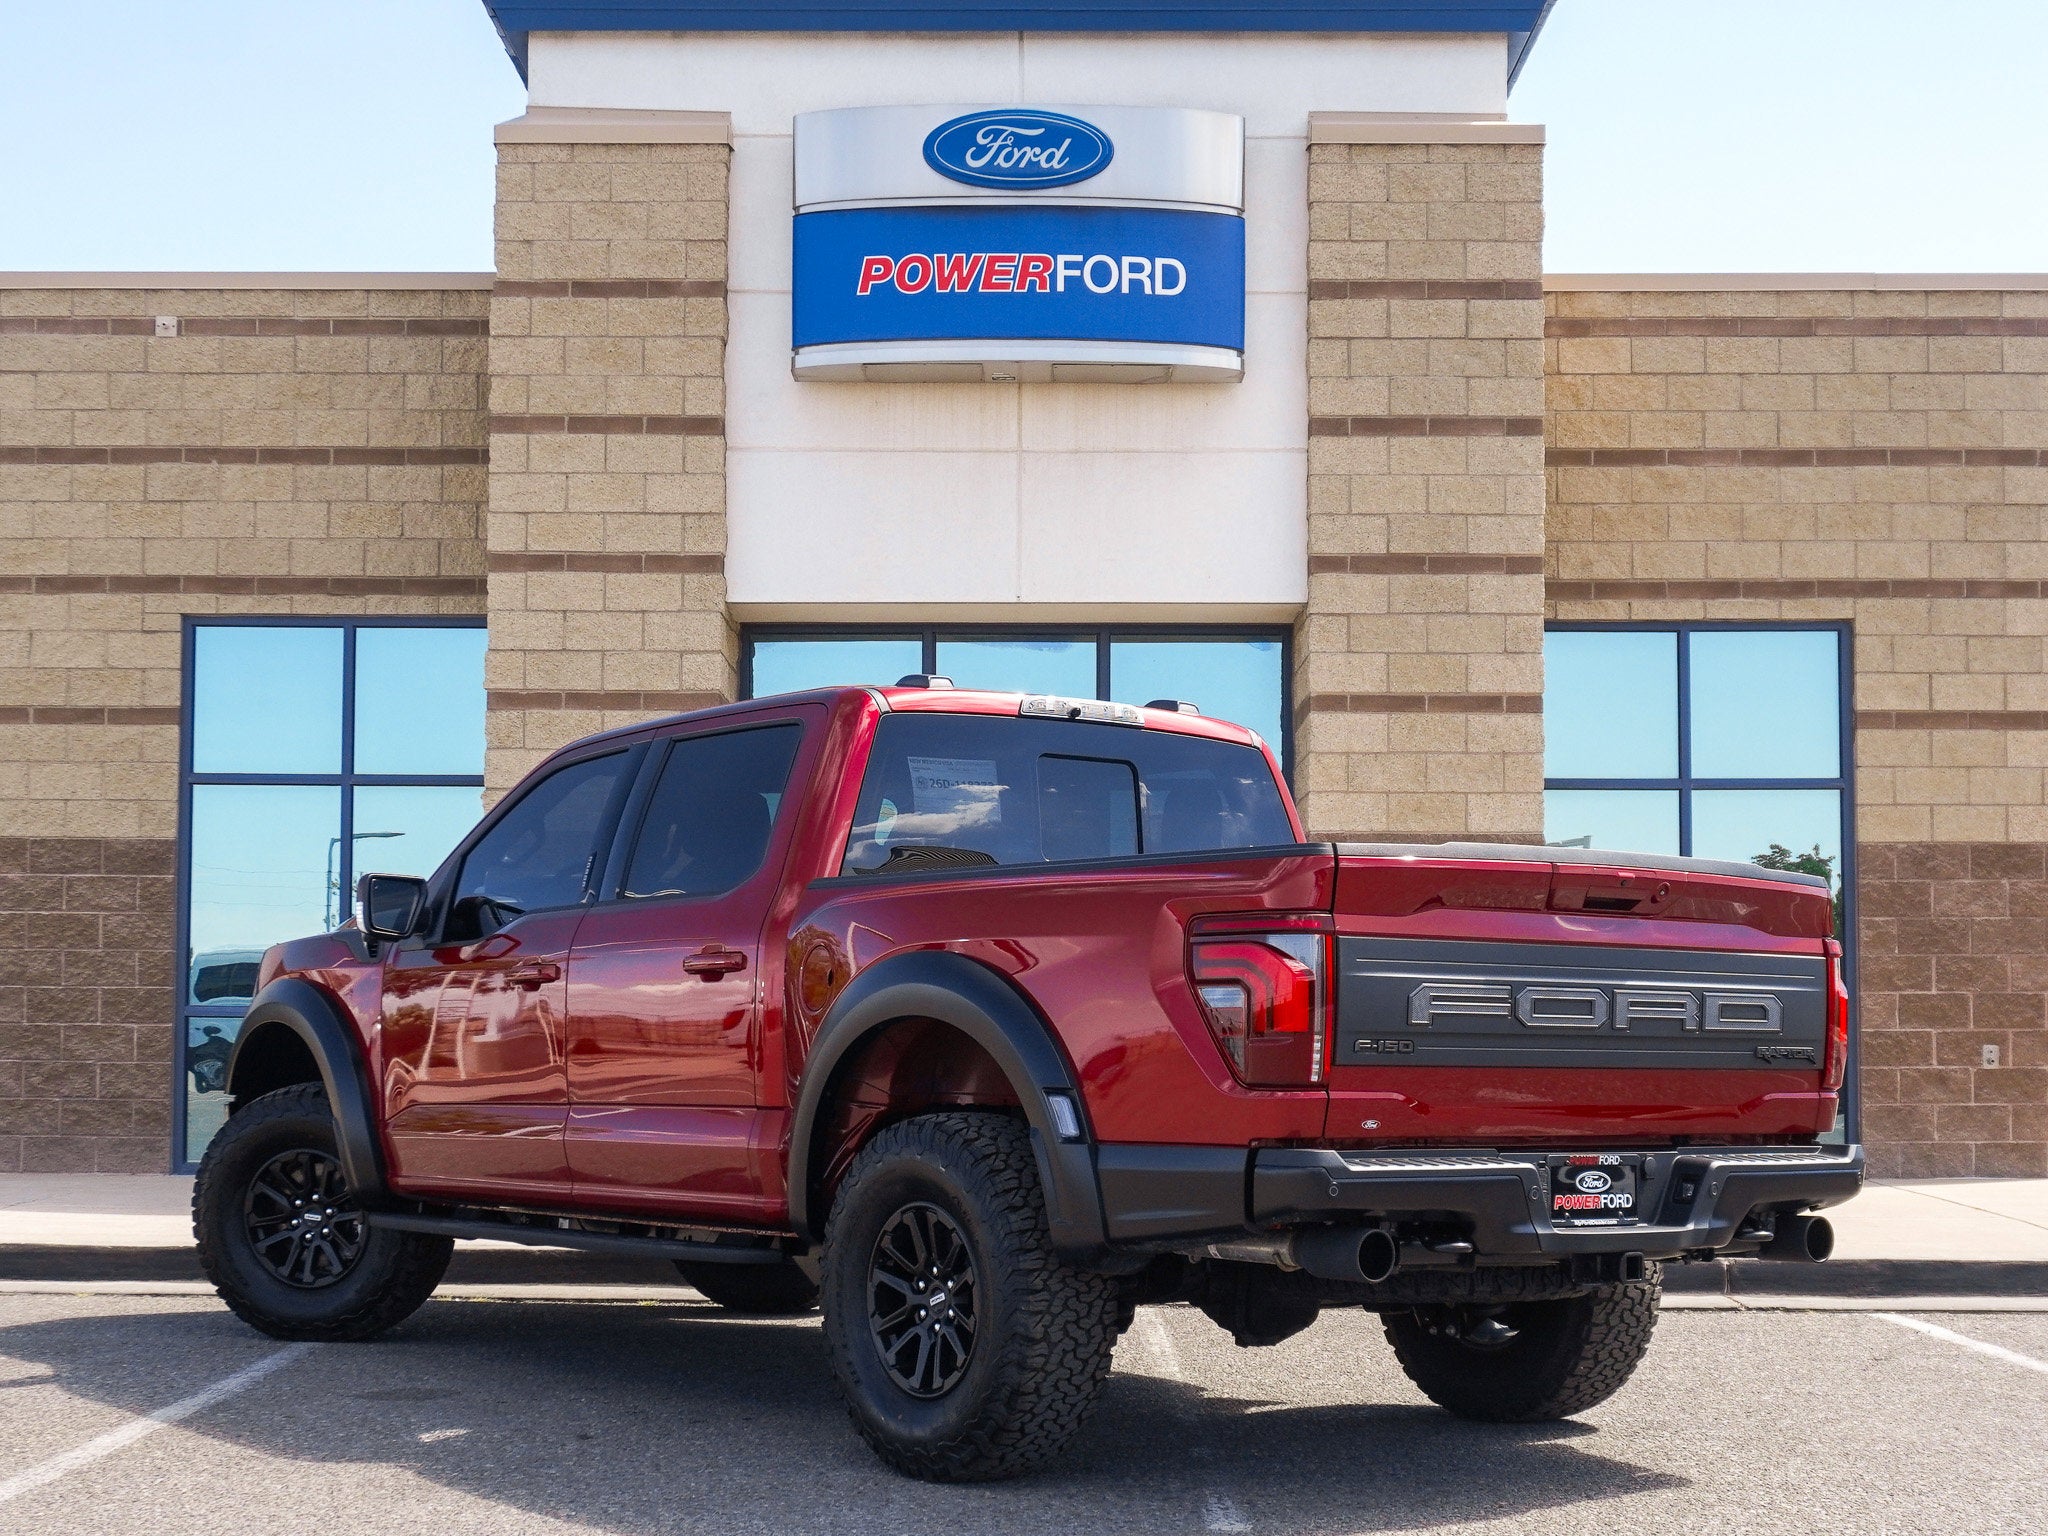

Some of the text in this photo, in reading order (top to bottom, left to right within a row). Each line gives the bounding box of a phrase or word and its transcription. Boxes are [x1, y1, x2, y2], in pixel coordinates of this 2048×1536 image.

[965, 125, 1072, 169] Ford
[856, 253, 1188, 296] POWERFORD
[1408, 982, 1784, 1033] FORD
[1354, 1039, 1414, 1053] F-150
[1756, 1046, 1816, 1064] RAPTOR
[1583, 1176, 1604, 1188] Ford
[1554, 1194, 1632, 1210] POWERFORD
